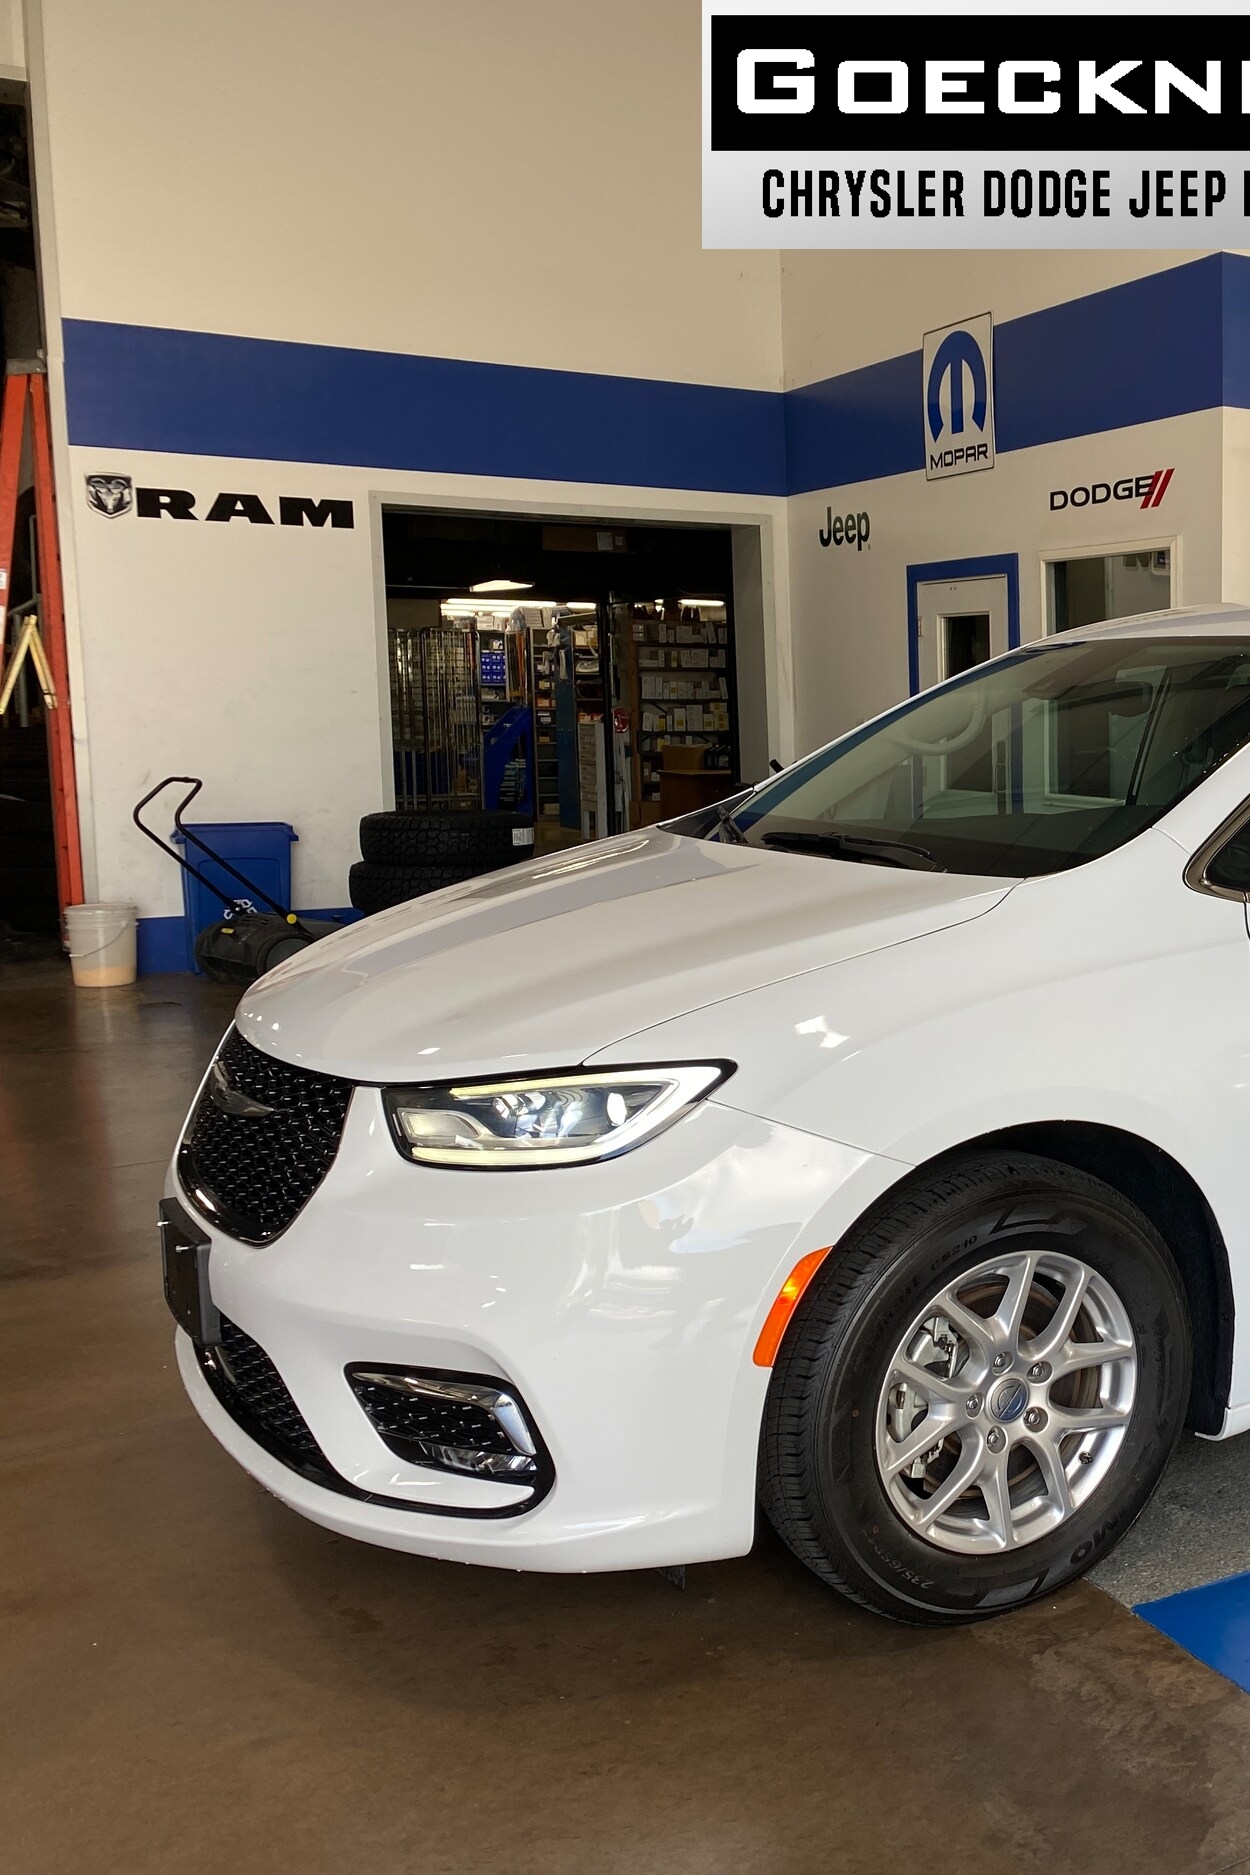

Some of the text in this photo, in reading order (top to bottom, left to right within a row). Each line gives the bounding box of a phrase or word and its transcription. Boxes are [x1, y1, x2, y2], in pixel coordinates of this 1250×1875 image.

[930, 442, 990, 471] MOPAR
[135, 487, 355, 530] RAM
[1050, 474, 1156, 511] DODGE
[818, 505, 871, 552] Jeep
